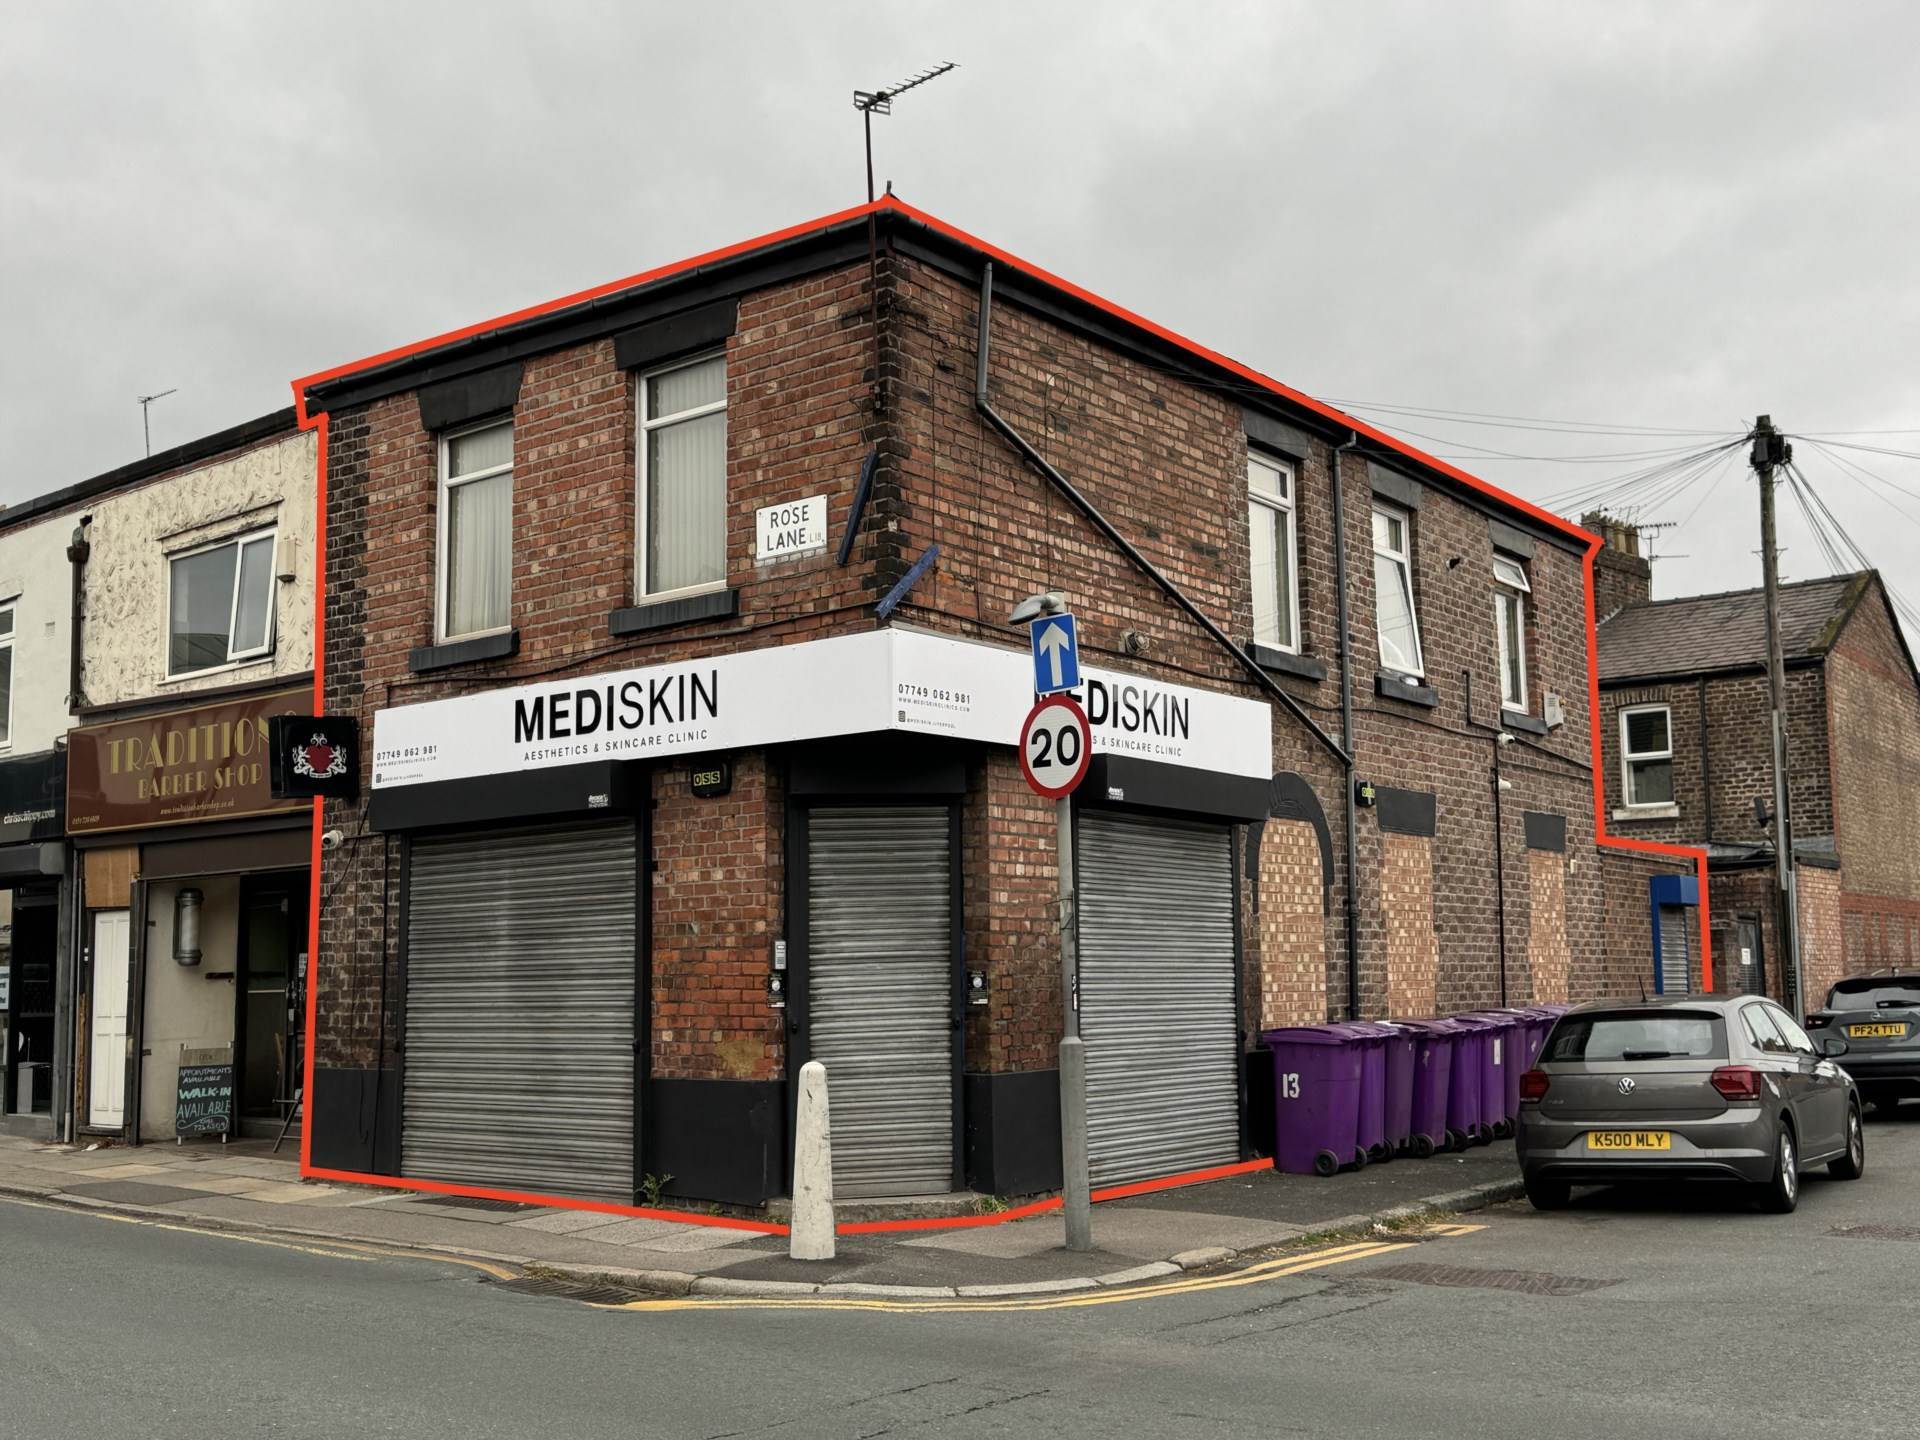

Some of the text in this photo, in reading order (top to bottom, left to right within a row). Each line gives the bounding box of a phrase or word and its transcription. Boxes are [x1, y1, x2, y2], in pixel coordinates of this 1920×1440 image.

[771, 505, 809, 528] ROSE
[767, 528, 806, 551] LANE
[899, 684, 970, 705] 07749 062 981
[515, 670, 717, 743] MEDISKIN
[1034, 678, 1188, 740] DISKIN
[525, 729, 708, 761] AESTHETICS & SKINCARE CLINIC
[1031, 725, 1080, 768] 20
[1101, 737, 1106, 746] &
[1110, 738, 1151, 753] SKINCARE
[1155, 745, 1182, 757] CLINIC
[138, 763, 262, 799] BARBER SHOP
[1854, 1025, 1901, 1035] PF24 TTU
[179, 1087, 232, 1099] WALK-IN
[1282, 1072, 1300, 1098] 13
[177, 1100, 231, 1119] AVAILABLE
[1594, 1133, 1664, 1146] K500 MLY
